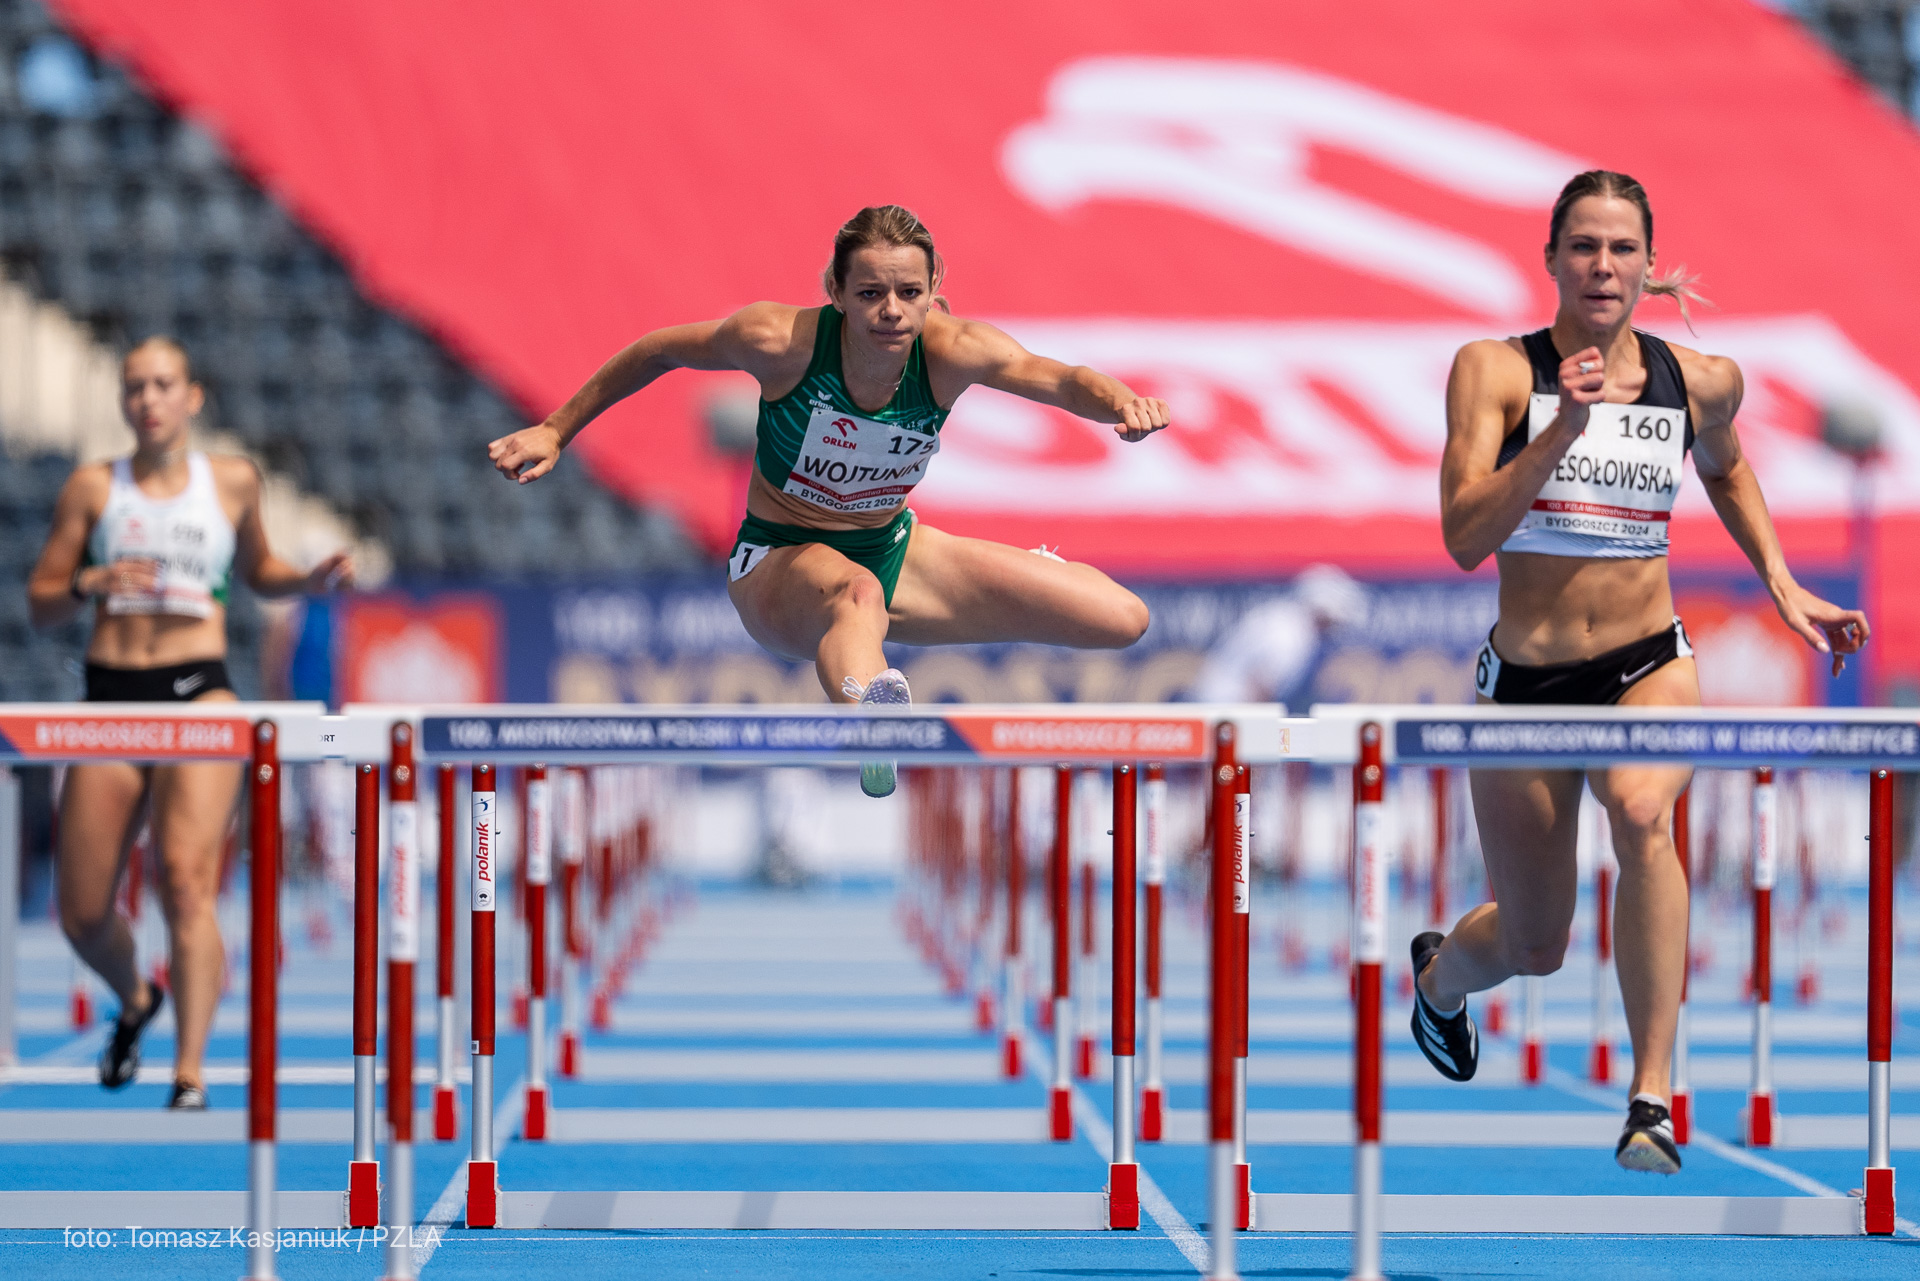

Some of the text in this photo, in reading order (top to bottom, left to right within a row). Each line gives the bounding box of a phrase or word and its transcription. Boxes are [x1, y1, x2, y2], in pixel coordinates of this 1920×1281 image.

[808, 399, 833, 410] erima
[1619, 415, 1671, 441] 160
[822, 435, 857, 450] ORLEN
[888, 435, 936, 455] 175
[804, 455, 926, 484] WOJTUNIK
[1548, 455, 1673, 495] ESOŁOWSKA
[801, 488, 902, 511] BYDGOSZCZ 2024
[840, 489, 881, 501] Mistrzostwa
[882, 486, 904, 494] Polski
[1545, 516, 1649, 535] BYDGOSZCZ 2024
[1476, 647, 1492, 690] 6
[476, 821, 491, 882] polanik
[1234, 824, 1245, 883] polanik
